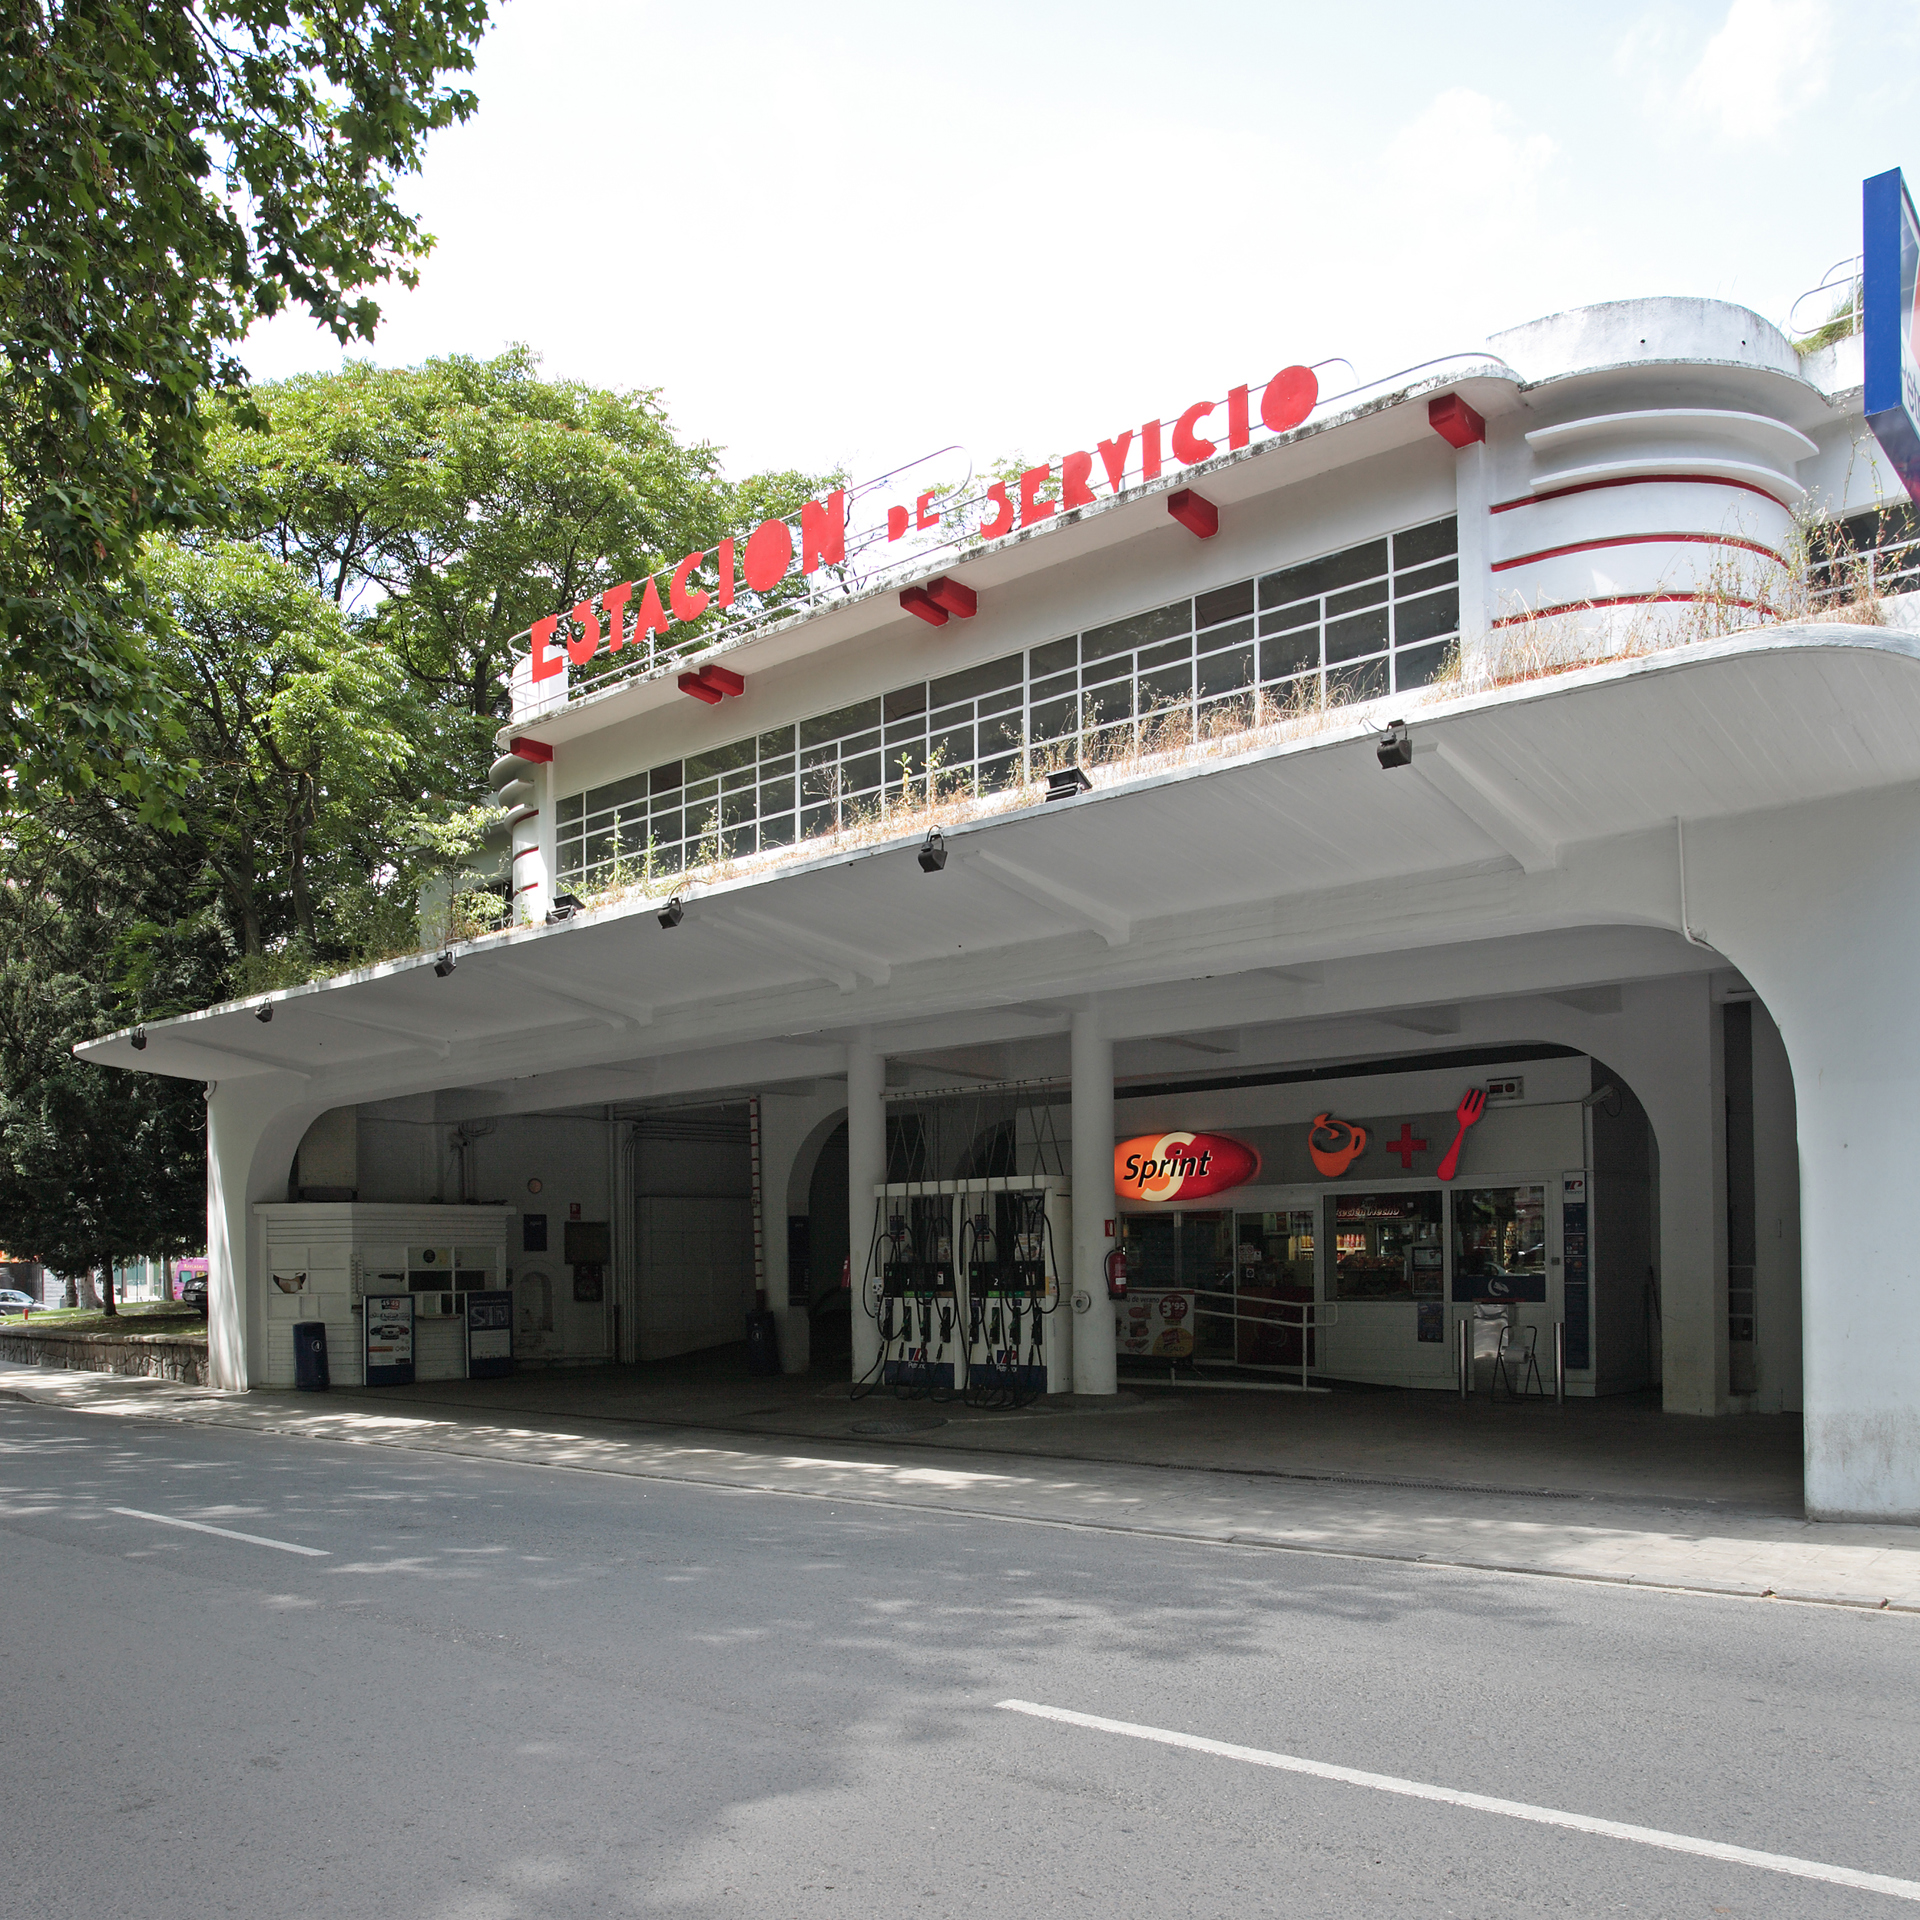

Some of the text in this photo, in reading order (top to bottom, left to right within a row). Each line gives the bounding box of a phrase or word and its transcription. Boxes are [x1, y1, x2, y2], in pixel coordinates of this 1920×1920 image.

[529, 365, 1319, 685] ESTACION DE SERVICIO
[1123, 1149, 1213, 1188] Sprint
[993, 1278, 999, 1286] 2
